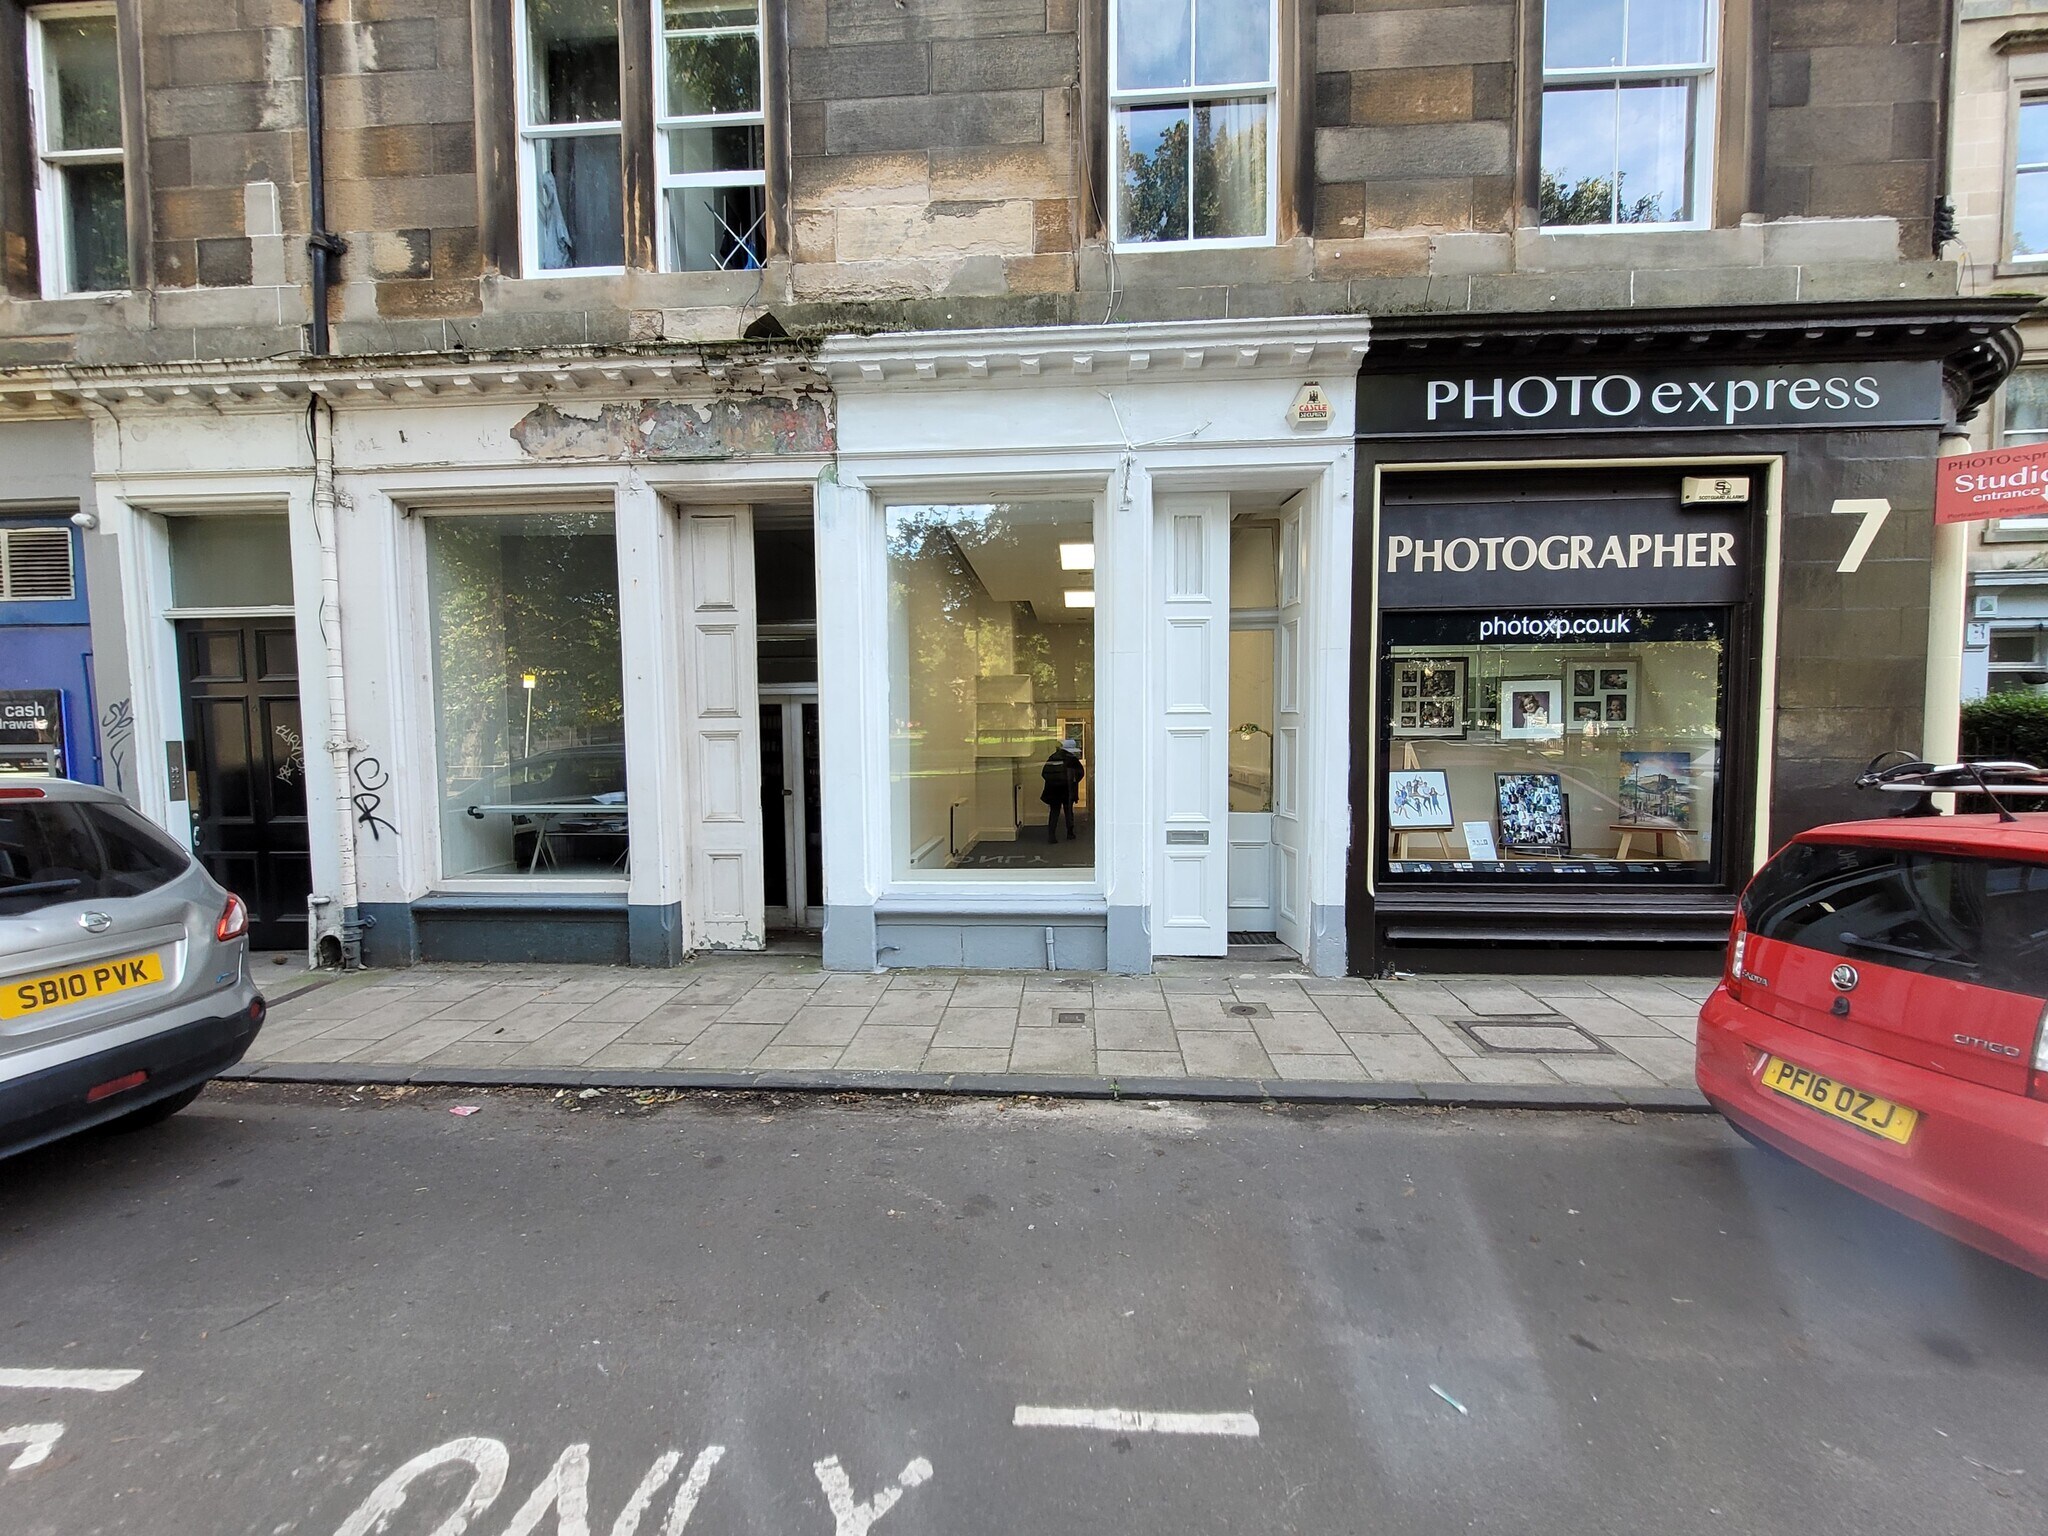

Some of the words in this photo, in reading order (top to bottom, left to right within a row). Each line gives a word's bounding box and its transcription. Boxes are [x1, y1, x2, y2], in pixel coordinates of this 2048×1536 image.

[1299, 404, 1328, 412] CASTLE
[1973, 487, 2040, 503] entrance
[1831, 498, 1892, 573] 7
[1387, 532, 1736, 573] PHOTOGRAPHER
[1479, 614, 1631, 640] photoxp.co.uk
[4, 701, 46, 717] cash
[93, 960, 148, 991] PVK
[1953, 1033, 2020, 1057] CITIGO
[1775, 1063, 1832, 1103] PF16
[1834, 1086, 1896, 1129] OZJ
